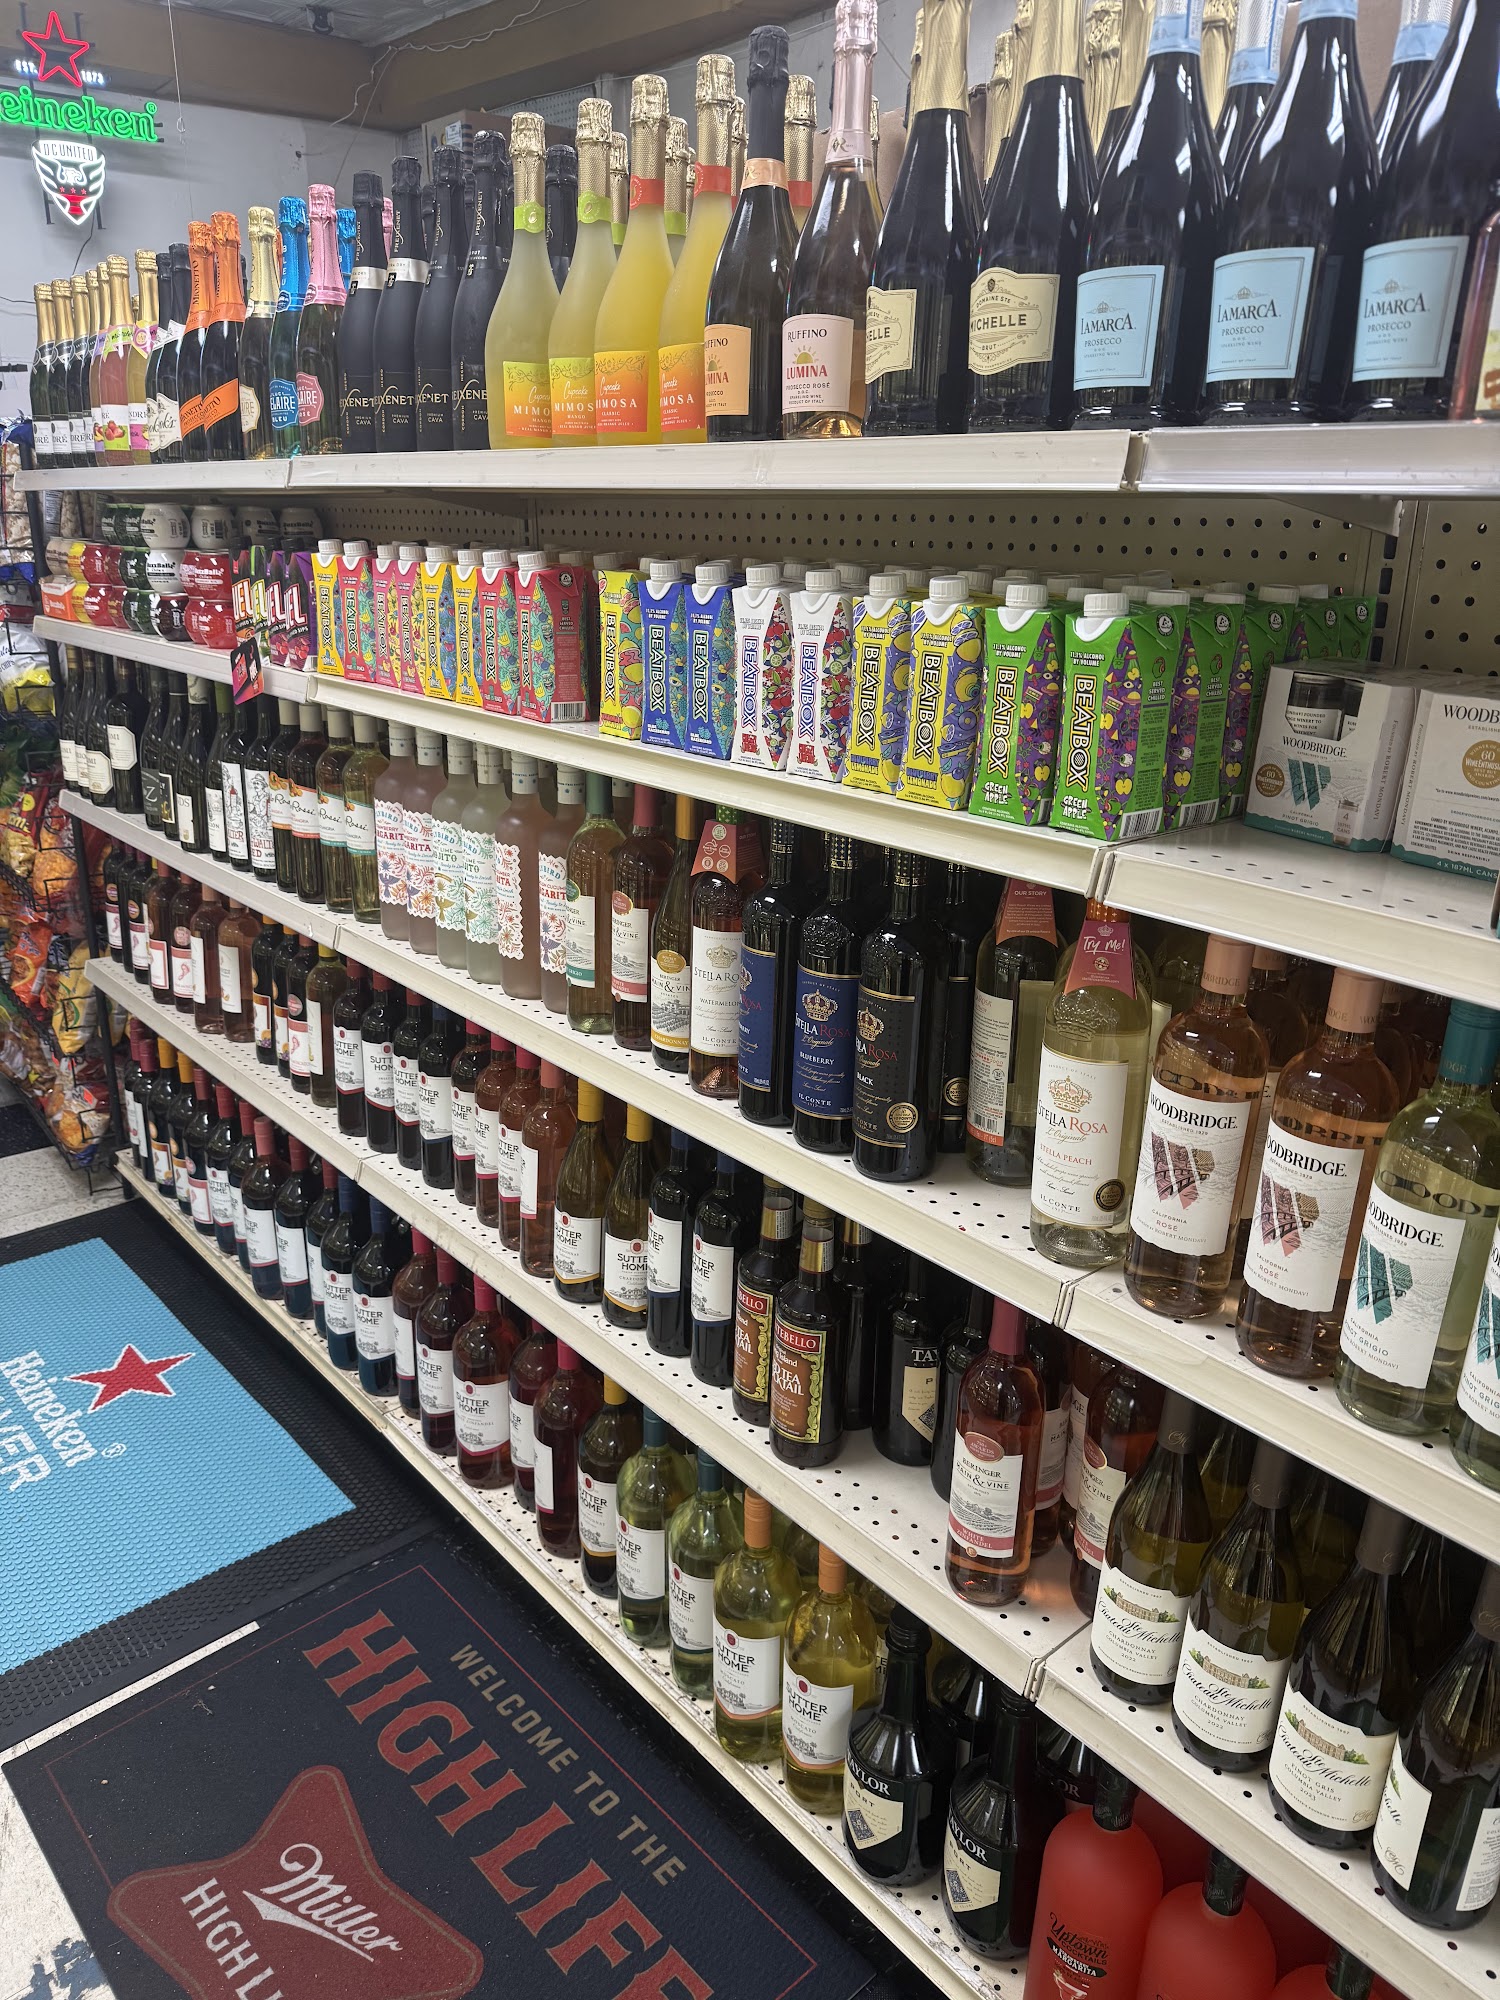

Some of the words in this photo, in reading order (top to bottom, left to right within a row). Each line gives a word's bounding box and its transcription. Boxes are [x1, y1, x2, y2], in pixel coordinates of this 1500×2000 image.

[976, 296, 999, 309] DOMAINE
[1000, 296, 1012, 304] STE
[970, 313, 1028, 333] MICHELLE
[1221, 325, 1265, 338] PROSECCO
[1367, 321, 1412, 334] PROSECCO
[787, 328, 827, 343] RUFFINO
[1084, 337, 1123, 347] PROSECCO
[981, 342, 998, 351] BRUT
[786, 364, 828, 380] LUMINA
[563, 381, 589, 400] Cupcake
[600, 377, 622, 396] Cupcake
[661, 373, 678, 394] Cupcake
[812, 381, 831, 389] ROSÉ
[356, 418, 372, 426] CAVA
[393, 417, 409, 425] CAVA
[320, 587, 332, 651] BEATBOX
[346, 589, 358, 655] BEATBOX
[377, 592, 387, 659] BEATBOX
[402, 595, 412, 664] BEATBOX
[428, 599, 438, 669] BEATBOX
[458, 602, 470, 675] BEATBOX
[485, 606, 497, 683] BEATBOX
[521, 610, 531, 687] BEATBOX
[1006, 644, 1027, 654] ALCOHOL
[605, 612, 616, 702] BEATBOX
[1003, 651, 1021, 659] VOLUME
[1073, 658, 1080, 666] BY
[1081, 659, 1100, 667] VOLUME
[1084, 652, 1105, 662] ALCOHOL
[650, 625, 666, 714] BEATBOX
[693, 630, 709, 722] BEATBOX
[742, 635, 759, 732] BEATBOX
[798, 642, 818, 742] BEATBOX
[857, 643, 882, 750] BEATBOX
[914, 652, 942, 764] BEATBOX
[988, 666, 1017, 778] BEATBOX
[1066, 675, 1097, 791] BEATBOX
[1481, 750, 1496, 761] 60
[984, 782, 1008, 795] GREEN
[984, 791, 1009, 806] APPLE
[1063, 796, 1088, 809] GREEN
[1062, 805, 1089, 820] APPLE
[1282, 814, 1299, 822] PINOT
[1451, 864, 1474, 874] 187ML
[1476, 869, 1498, 878] CANS
[572, 918, 586, 926] VINE
[1083, 935, 1100, 954] Try
[1104, 935, 1126, 952] Me!
[694, 966, 723, 982] STELLA
[664, 980, 675, 993] &
[795, 1013, 819, 1035] STELLA
[820, 1026, 851, 1039] ROSA
[800, 1052, 834, 1066] BLUEBERRY
[868, 1044, 898, 1062] ROSA
[857, 1071, 874, 1087] BLACK
[805, 1095, 832, 1107] CONTE
[1038, 1099, 1067, 1129] STELLA
[1070, 1116, 1109, 1136] ROSA
[1161, 1118, 1195, 1135] ESTABLISHED
[1040, 1143, 1061, 1160] STELLA
[1063, 1154, 1093, 1166] PEACH
[1049, 1198, 1081, 1213] CONTE
[1152, 1208, 1188, 1225] CALIFORNIA
[1156, 1218, 1178, 1232] ROSÉ
[554, 1223, 582, 1240] SUTTER
[556, 1233, 579, 1247] HOME
[1154, 1228, 1177, 1240] ROBERT
[1256, 1252, 1289, 1273] CALIFORNIA
[1259, 1264, 1280, 1280] ROSÉ
[325, 1290, 349, 1301] HOME
[1278, 1283, 1310, 1298] MONDAVI
[354, 1304, 383, 1319] SUTTER
[356, 1312, 380, 1326] HOME
[1350, 1316, 1379, 1343] CALIFORNIA
[1358, 1336, 1389, 1357] GRIGIO
[778, 1353, 798, 1368] Island
[1367, 1352, 1400, 1370] MONDAVI
[781, 1369, 801, 1385] TEA
[1463, 1374, 1480, 1394] PINOT
[0, 1350, 98, 1468] Heineken
[455, 1391, 490, 1408] SUTTER
[458, 1400, 486, 1415] HOME
[970, 1442, 996, 1455] AWARDS
[956, 1461, 972, 1481] MAIN
[972, 1473, 986, 1489] &
[986, 1481, 1010, 1490] VINE
[962, 1456, 1003, 1479] BERINGER
[1091, 1485, 1112, 1503] VINE
[956, 1529, 993, 1550] ZINFANDEL
[962, 1528, 985, 1542] WHITE
[1098, 1599, 1132, 1637] Chateau
[1122, 1614, 1144, 1632] Ste
[1108, 1630, 1156, 1656] CHARDONNAY
[1130, 1623, 1183, 1646] Michelle
[715, 1635, 756, 1666] SUTTER
[1105, 1634, 1134, 1656] COLUMBIA
[1134, 1649, 1159, 1662] VALLEY
[717, 1651, 750, 1674] HOME
[1121, 1653, 1137, 1663] 2022
[1182, 1658, 1220, 1700] Chateau
[1208, 1679, 1231, 1698] Ste
[786, 1682, 829, 1715] SUTTER
[1193, 1694, 1246, 1721] CHARDONNAY
[1217, 1691, 1272, 1711] Michelle
[788, 1697, 823, 1723] HOME
[1190, 1699, 1222, 1722] COLUMBIA
[1222, 1716, 1248, 1728] VALLEY
[302, 1608, 527, 1838] HIGH
[1207, 1720, 1224, 1731] 2022
[1278, 1724, 1314, 1768] Chateau
[449, 1642, 581, 1776] WELCOME
[572, 1770, 621, 1818] TO
[616, 1814, 688, 1887] THE
[1301, 1749, 1325, 1772] Ste
[1284, 1764, 1315, 1790] COLUMBIA
[1316, 1787, 1343, 1803] VALLEY
[1290, 1762, 1313, 1784] PINOT
[1315, 1781, 1336, 1794] GRIS
[1311, 1764, 1372, 1788] Michelle
[1299, 1786, 1318, 1801] 2023
[262, 1842, 404, 1954] Miller
[180, 1877, 260, 1979] HIGH
[1049, 1911, 1109, 1960] Uptown
[1052, 1944, 1098, 1977] MARGARITA
[1061, 1940, 1108, 1966] COCKTAILS
